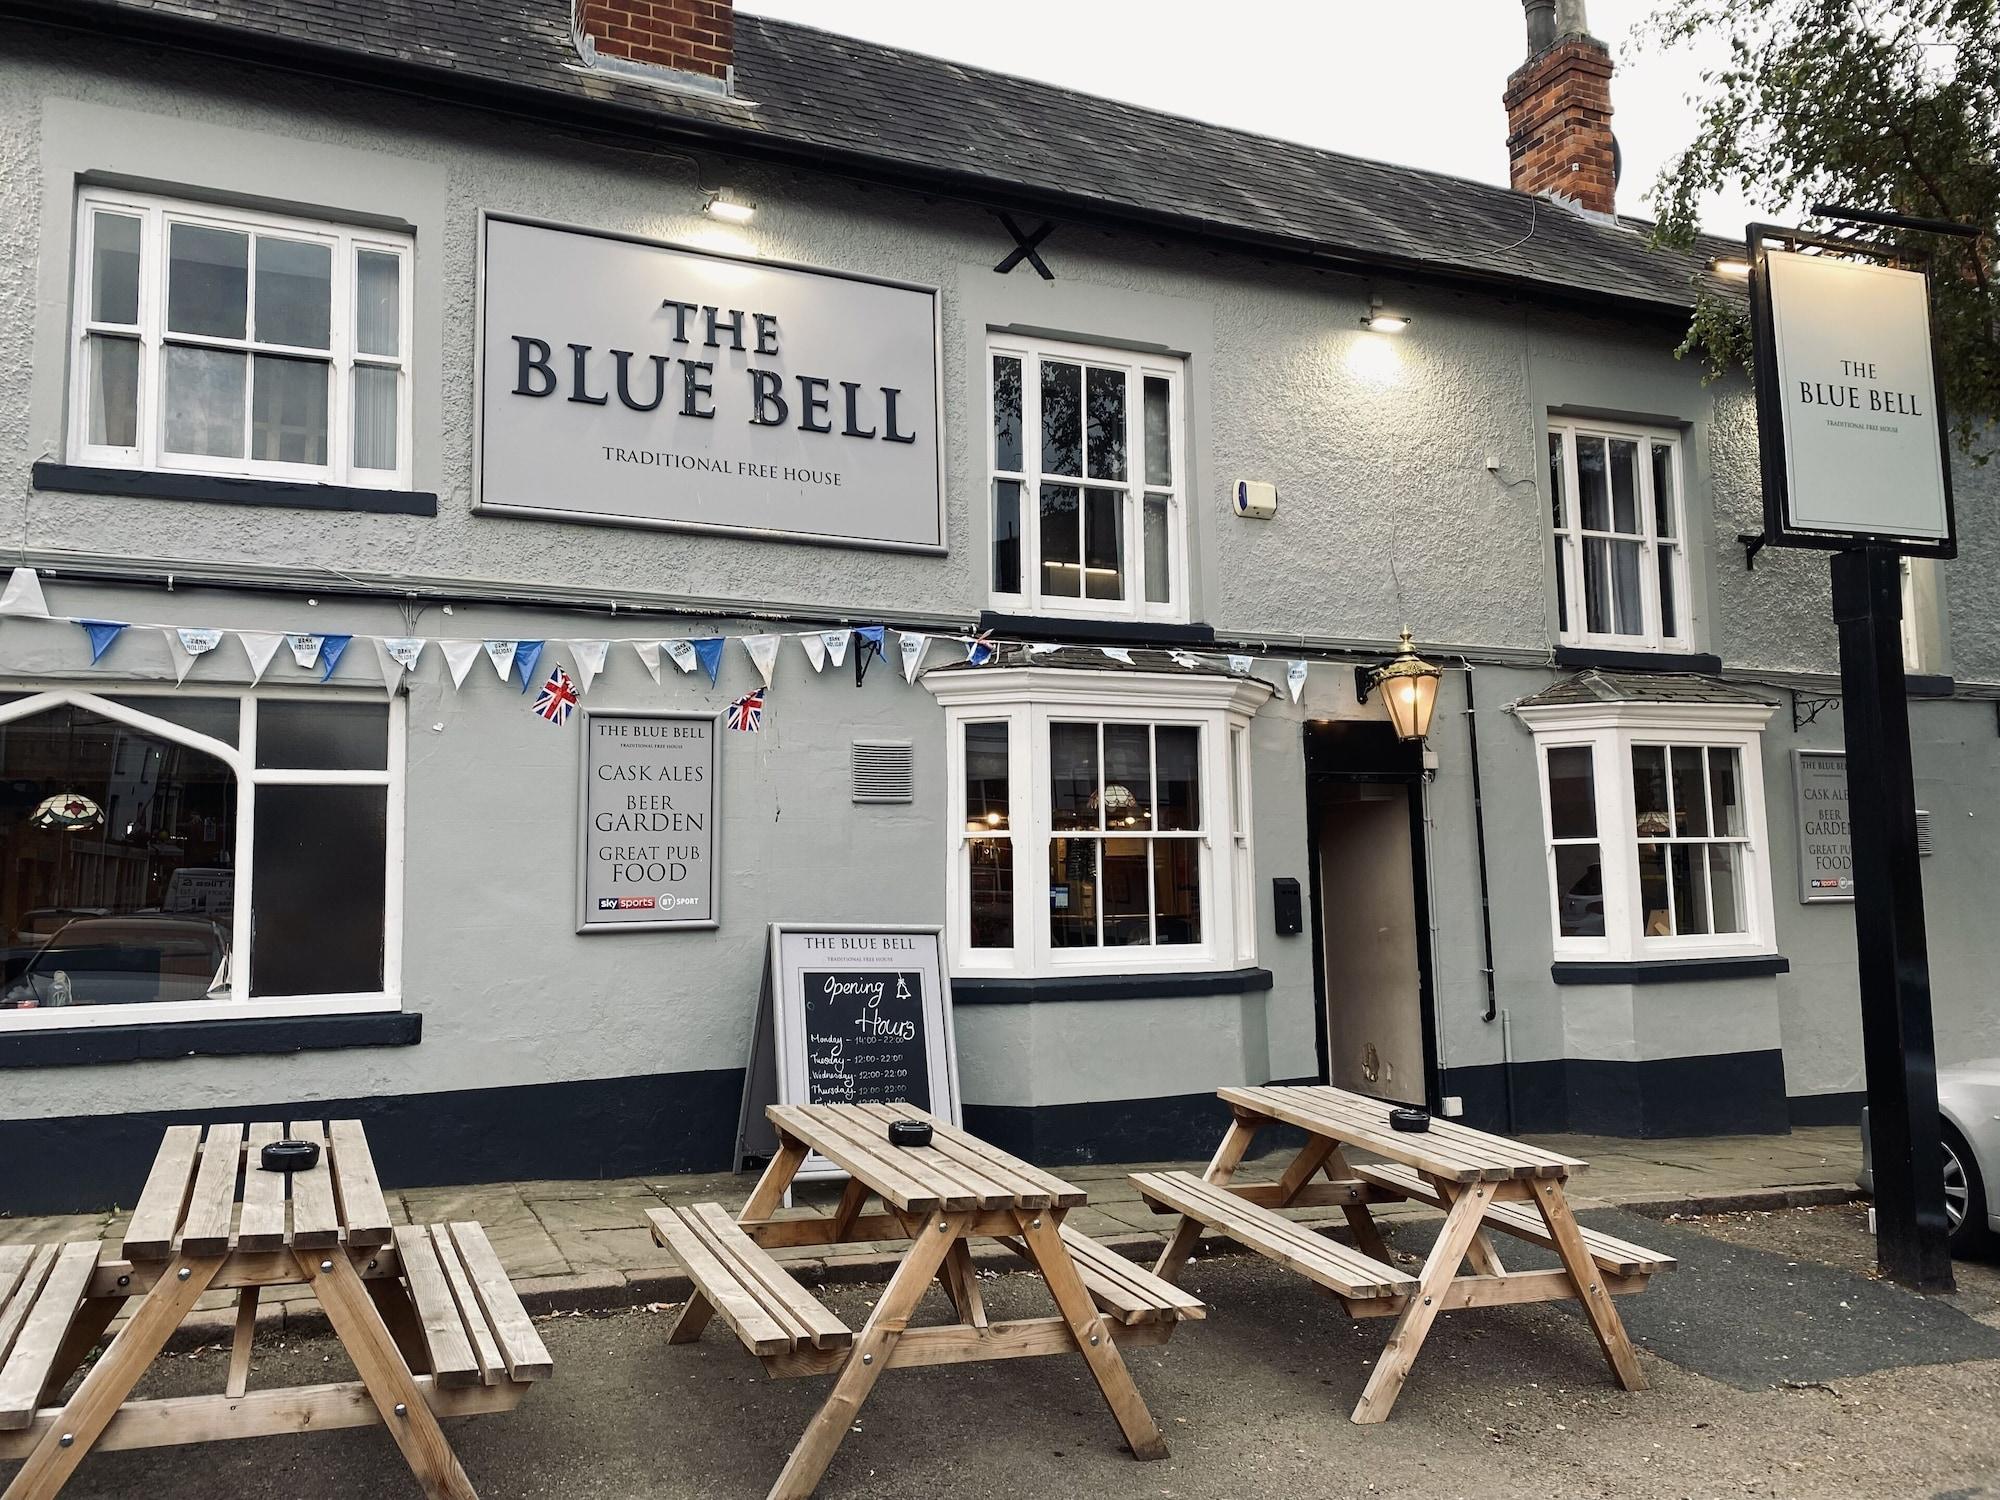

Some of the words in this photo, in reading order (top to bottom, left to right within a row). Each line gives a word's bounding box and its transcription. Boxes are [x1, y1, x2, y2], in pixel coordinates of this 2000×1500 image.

[662, 299, 780, 356] THE
[1840, 359, 1877, 379] THE
[511, 335, 716, 419] BLUE
[747, 367, 916, 444] BELL
[1800, 381, 1860, 409] BLUE
[1869, 389, 1922, 416] BELL
[1826, 419, 1865, 431] TRADITIONAL
[1866, 423, 1878, 431] FREE
[1879, 424, 1898, 433] HOUSE
[602, 446, 733, 474] TRADITIONAL
[738, 462, 778, 479] FREE
[784, 467, 842, 487] HOUSE
[598, 725, 628, 736] THE
[634, 726, 668, 738] BLUE
[674, 727, 705, 739] BELL
[598, 764, 652, 782] CASK
[658, 765, 704, 782] ALES
[1801, 761, 1816, 770] THE
[1817, 761, 1835, 770] BLUE
[627, 795, 674, 810] BEER
[1804, 788, 1830, 800] CASK
[1832, 789, 1849, 801] ALE
[595, 812, 704, 832] GARDEN
[1819, 809, 1841, 820] BEER
[598, 846, 660, 861] GREAT
[667, 846, 700, 860] PUB
[1809, 844, 1837, 855] GREAT
[1840, 844, 1851, 855] PU
[612, 862, 687, 882] FOOD
[1816, 856, 1851, 870] FOOD
[600, 898, 618, 909] sky
[620, 897, 654, 909] sports
[676, 897, 699, 906] SPORT
[804, 937, 836, 949] THE
[841, 938, 877, 950] BLUE
[883, 938, 916, 950] BELL
[824, 976, 885, 1008] Opening
[854, 1007, 915, 1040] Hours
[810, 1033, 843, 1057] Monday
[810, 1052, 845, 1073] Tuesday
